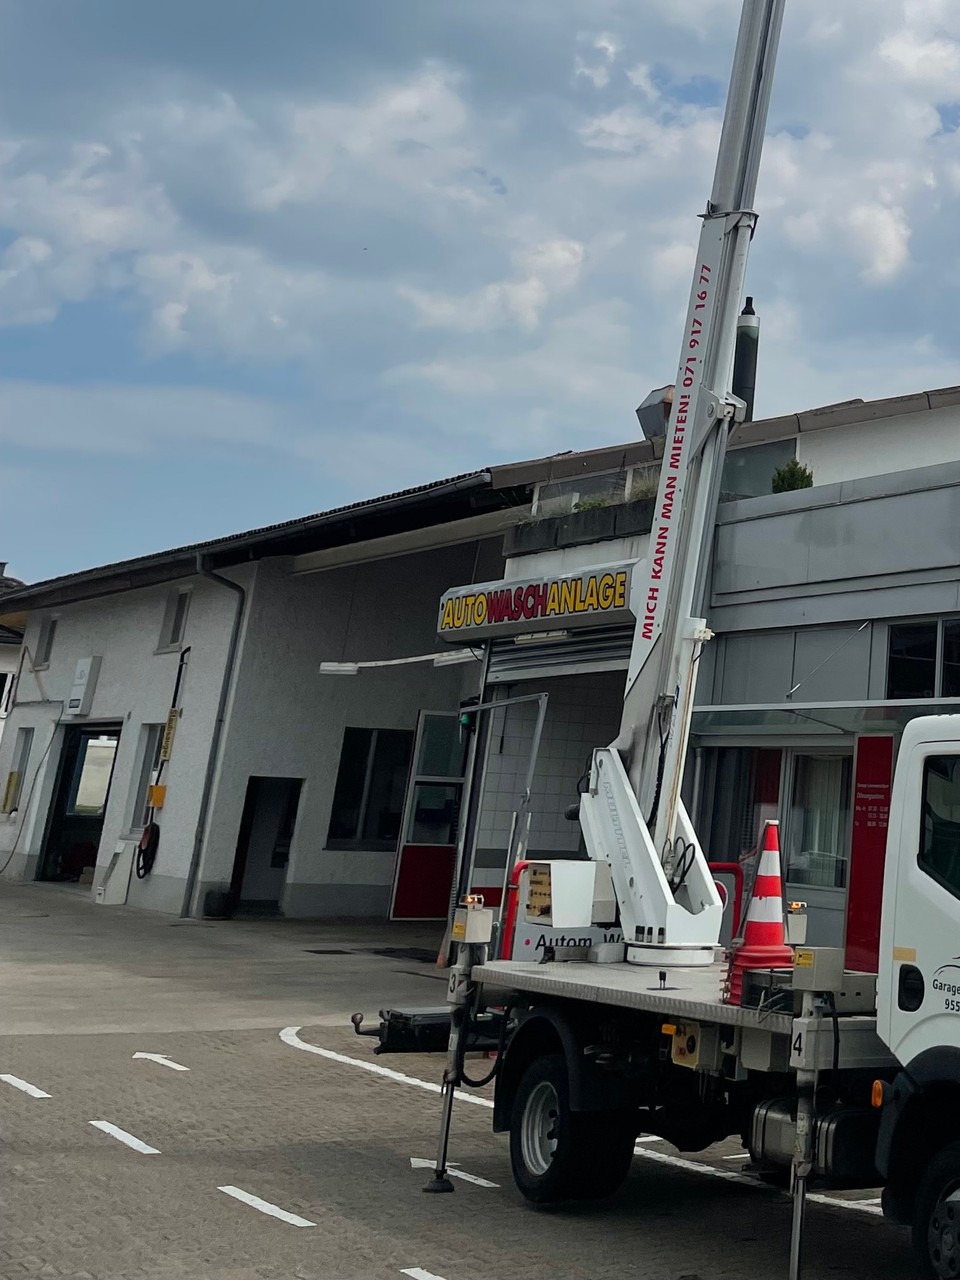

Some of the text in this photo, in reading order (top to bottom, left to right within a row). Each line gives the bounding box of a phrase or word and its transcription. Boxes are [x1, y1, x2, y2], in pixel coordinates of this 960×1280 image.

[641, 264, 711, 640] MICH KANN MAN MIETEN! 071 917 16 77
[441, 571, 627, 630] AUTOWASCHANLAGE
[450, 973, 457, 993] 3
[793, 1032, 803, 1057] 4
